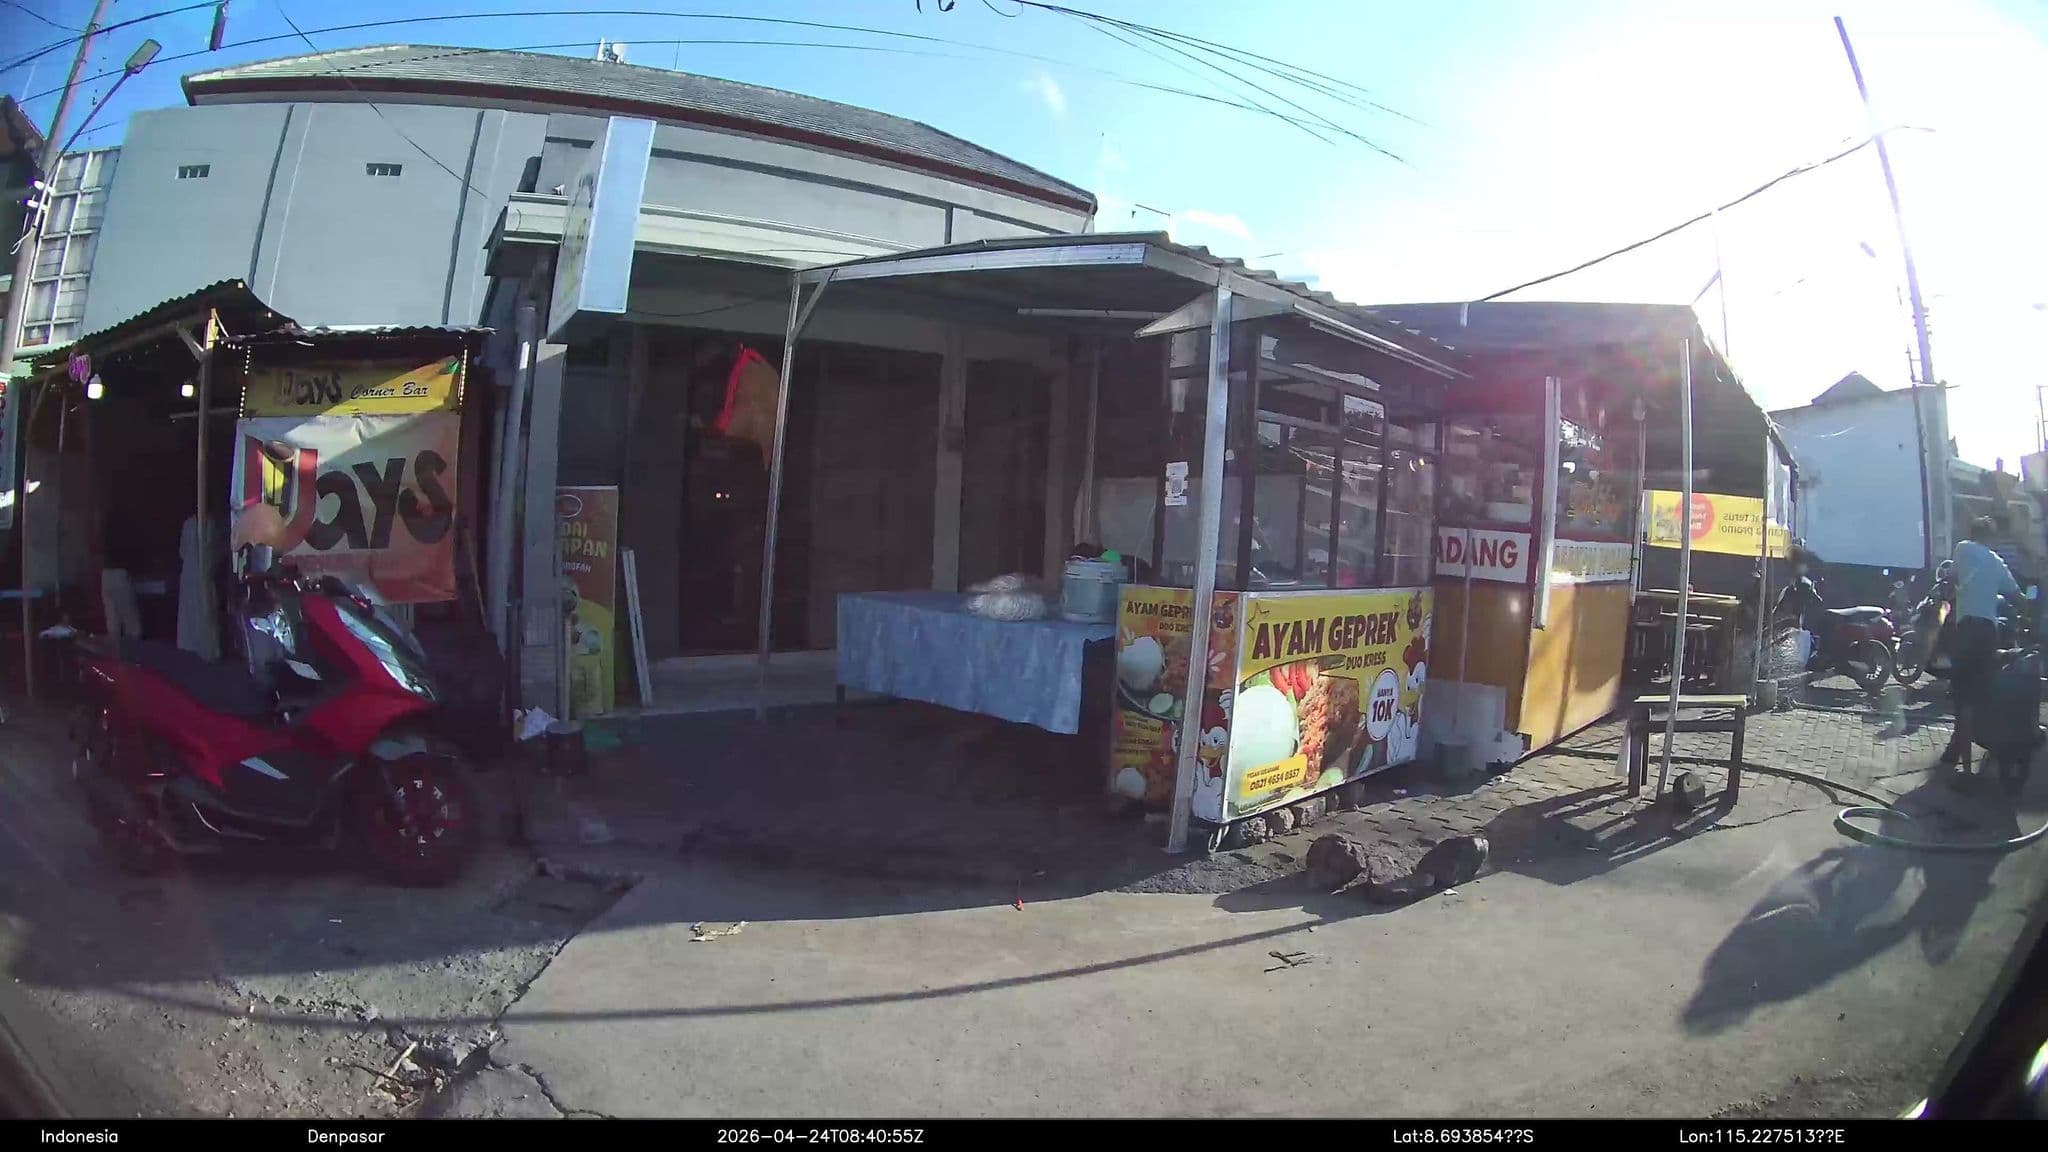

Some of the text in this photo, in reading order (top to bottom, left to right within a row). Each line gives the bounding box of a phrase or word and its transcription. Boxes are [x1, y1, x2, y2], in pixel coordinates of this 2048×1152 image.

[351, 384, 394, 399] Corner
[403, 382, 428, 395] Bar
[561, 538, 608, 558] APAN
[1432, 536, 1518, 569] ADANG
[1126, 601, 1192, 619] AYAM GEPR
[1252, 611, 1399, 660] AYAM GEPREK
[1346, 651, 1386, 670] DUO KRESS
[1372, 699, 1395, 722] 10K
